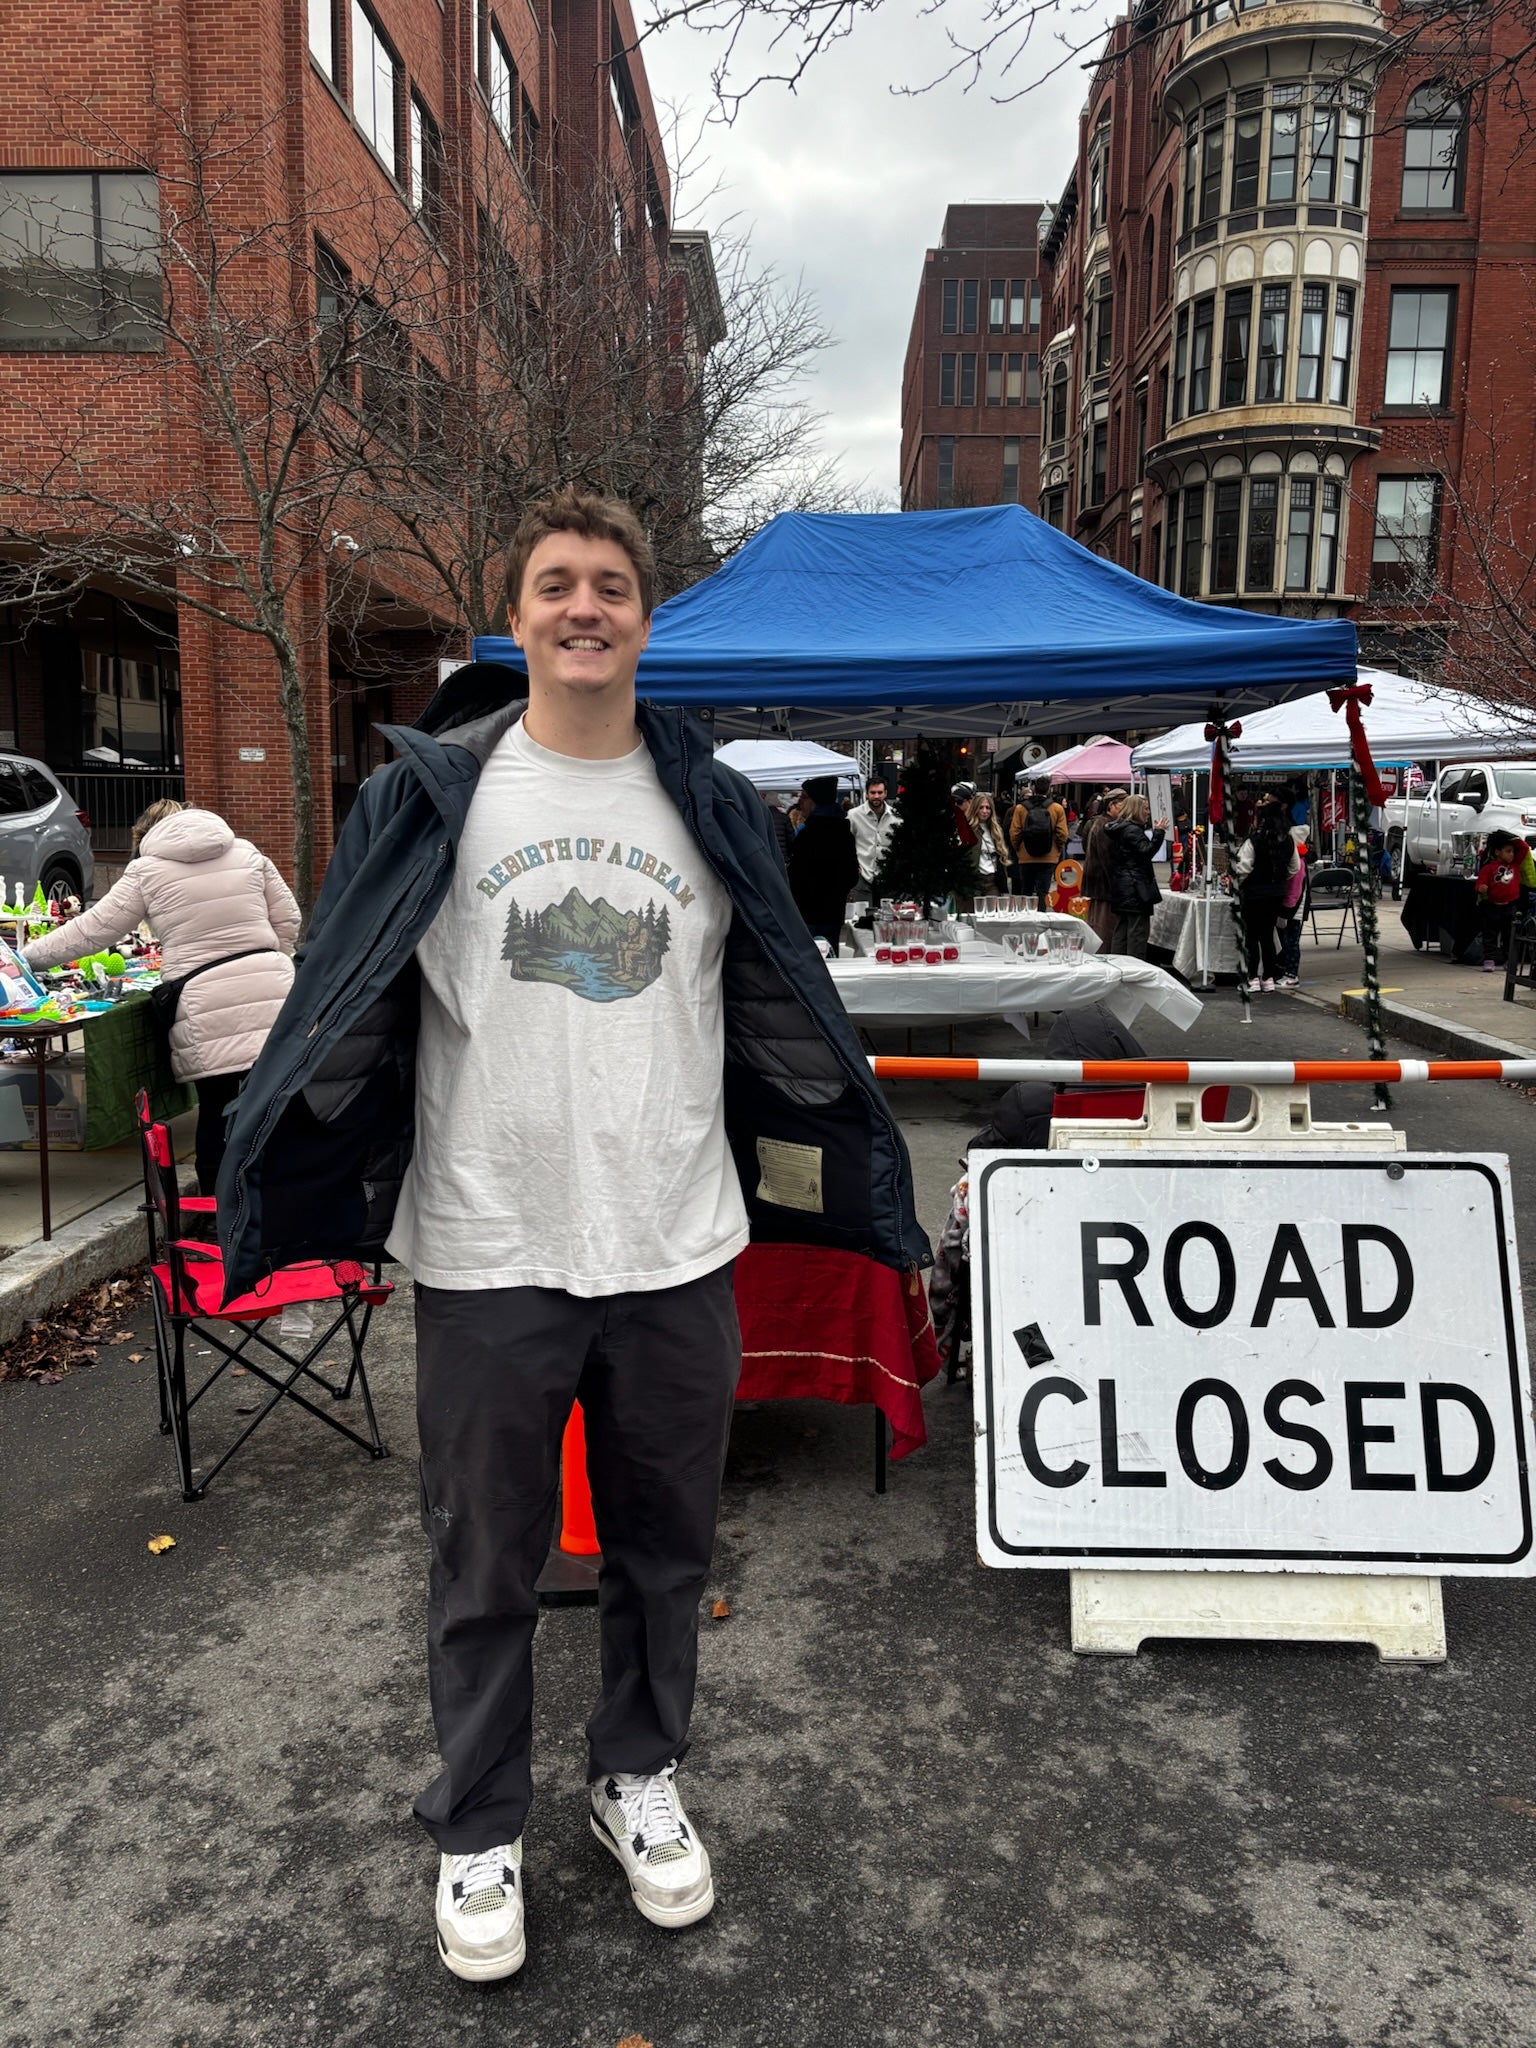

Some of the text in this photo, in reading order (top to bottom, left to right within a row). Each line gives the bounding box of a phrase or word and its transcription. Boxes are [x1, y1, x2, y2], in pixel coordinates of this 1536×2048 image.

[476, 837, 696, 909] REBIRTH OF A DREAM
[1080, 1220, 1414, 1329] ROAD
[1018, 1376, 1496, 1492] CLOSED
